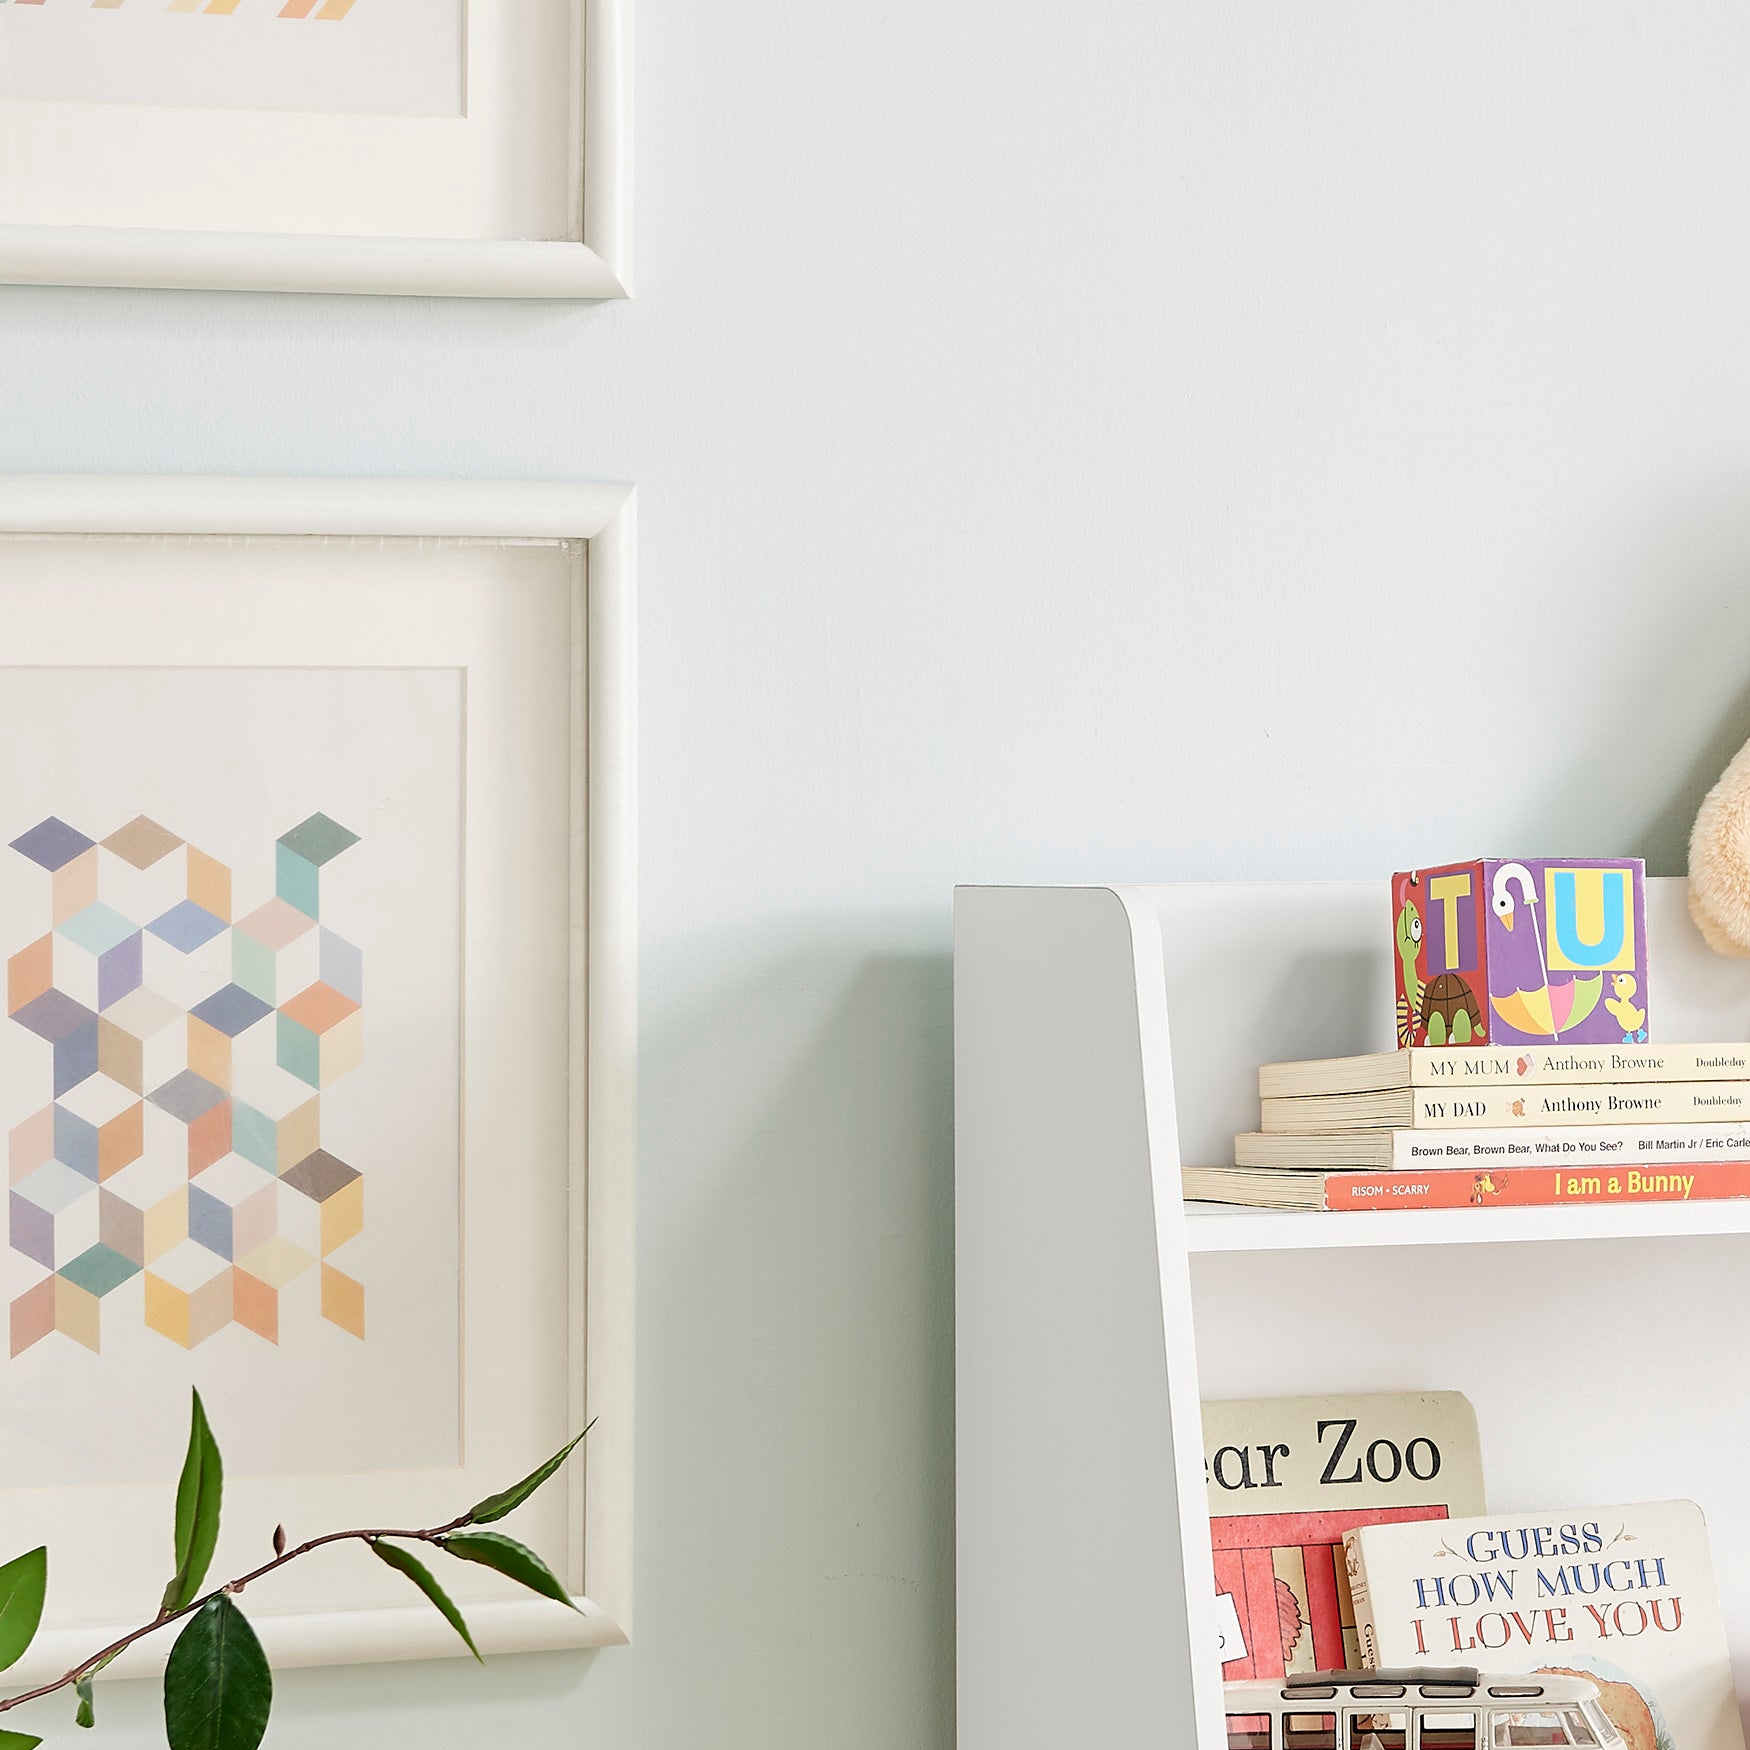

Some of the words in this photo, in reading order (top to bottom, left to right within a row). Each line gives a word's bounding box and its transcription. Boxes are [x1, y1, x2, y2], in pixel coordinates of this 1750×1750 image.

[1430, 873, 1471, 970] T
[1554, 871, 1625, 967] U
[1430, 1061, 1457, 1076] MY
[1464, 1060, 1509, 1075] MUM
[1542, 1055, 1605, 1072] Anthony
[1611, 1055, 1665, 1070] Browne
[1696, 1057, 1747, 1069] Doubleday
[1424, 1103, 1447, 1118] MY
[1453, 1102, 1486, 1117] DAD
[1540, 1097, 1602, 1114] Anthony
[1608, 1095, 1662, 1110] Browne
[1693, 1095, 1743, 1107] Doubleday
[1411, 1146, 1443, 1157] Brown
[1446, 1145, 1471, 1157] Bear,
[1473, 1144, 1505, 1155] Brown
[1508, 1143, 1532, 1155] Bear,
[1535, 1142, 1560, 1153] What
[1562, 1143, 1576, 1152] Do
[1579, 1142, 1597, 1152] You
[1599, 1141, 1623, 1151] See?
[1638, 1139, 1654, 1150] Bill
[1656, 1139, 1685, 1149] Martin
[1687, 1139, 1698, 1149] Jr
[1705, 1138, 1724, 1148] Eric
[1726, 1137, 1750, 1148] Carle
[1351, 1185, 1384, 1197] RISOM
[1392, 1184, 1430, 1196] SCARRY
[1555, 1172, 1561, 1195] I
[1566, 1176, 1601, 1195] am
[1607, 1175, 1622, 1194] a
[1627, 1170, 1695, 1200] Bunny
[1316, 1419, 1441, 1484] Zoo
[1466, 1521, 1603, 1563] GUESS
[1412, 1569, 1518, 1609] HOW
[1536, 1557, 1670, 1598] MUCH
[1410, 1619, 1430, 1655] I
[1446, 1608, 1574, 1653] LOVE
[1582, 1596, 1685, 1639] YOU
